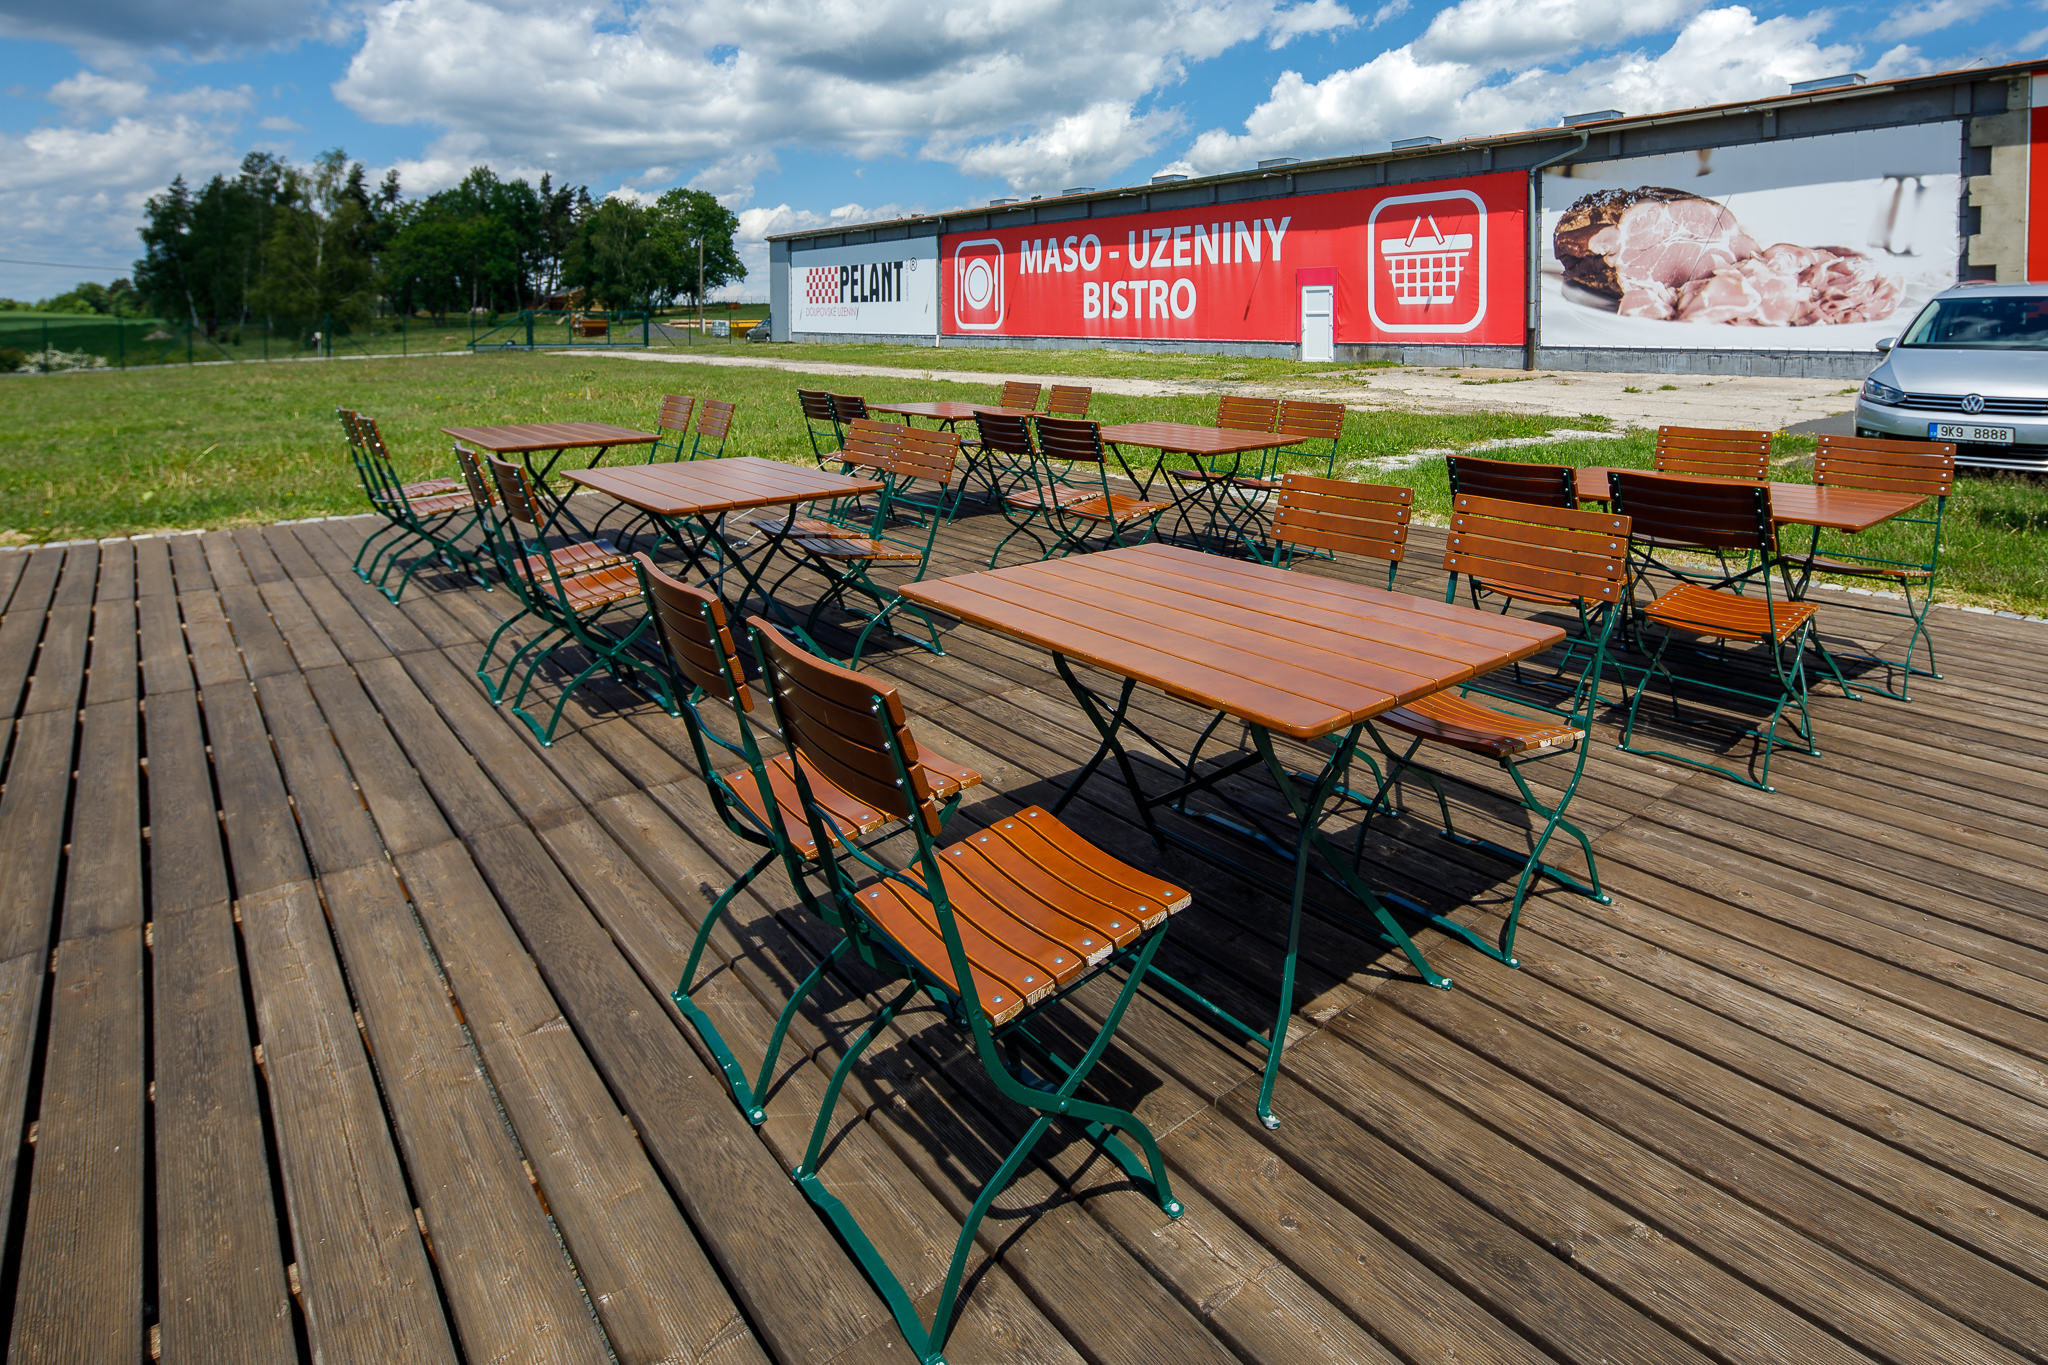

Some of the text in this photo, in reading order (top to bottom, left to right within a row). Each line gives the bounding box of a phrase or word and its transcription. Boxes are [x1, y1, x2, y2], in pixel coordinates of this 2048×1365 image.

[1019, 234, 1102, 275] MASO
[1128, 216, 1292, 270] UZENINY
[839, 260, 904, 303] PELANT
[1083, 277, 1198, 320] BISTRO
[1941, 426, 2007, 440] 9K9 8888
